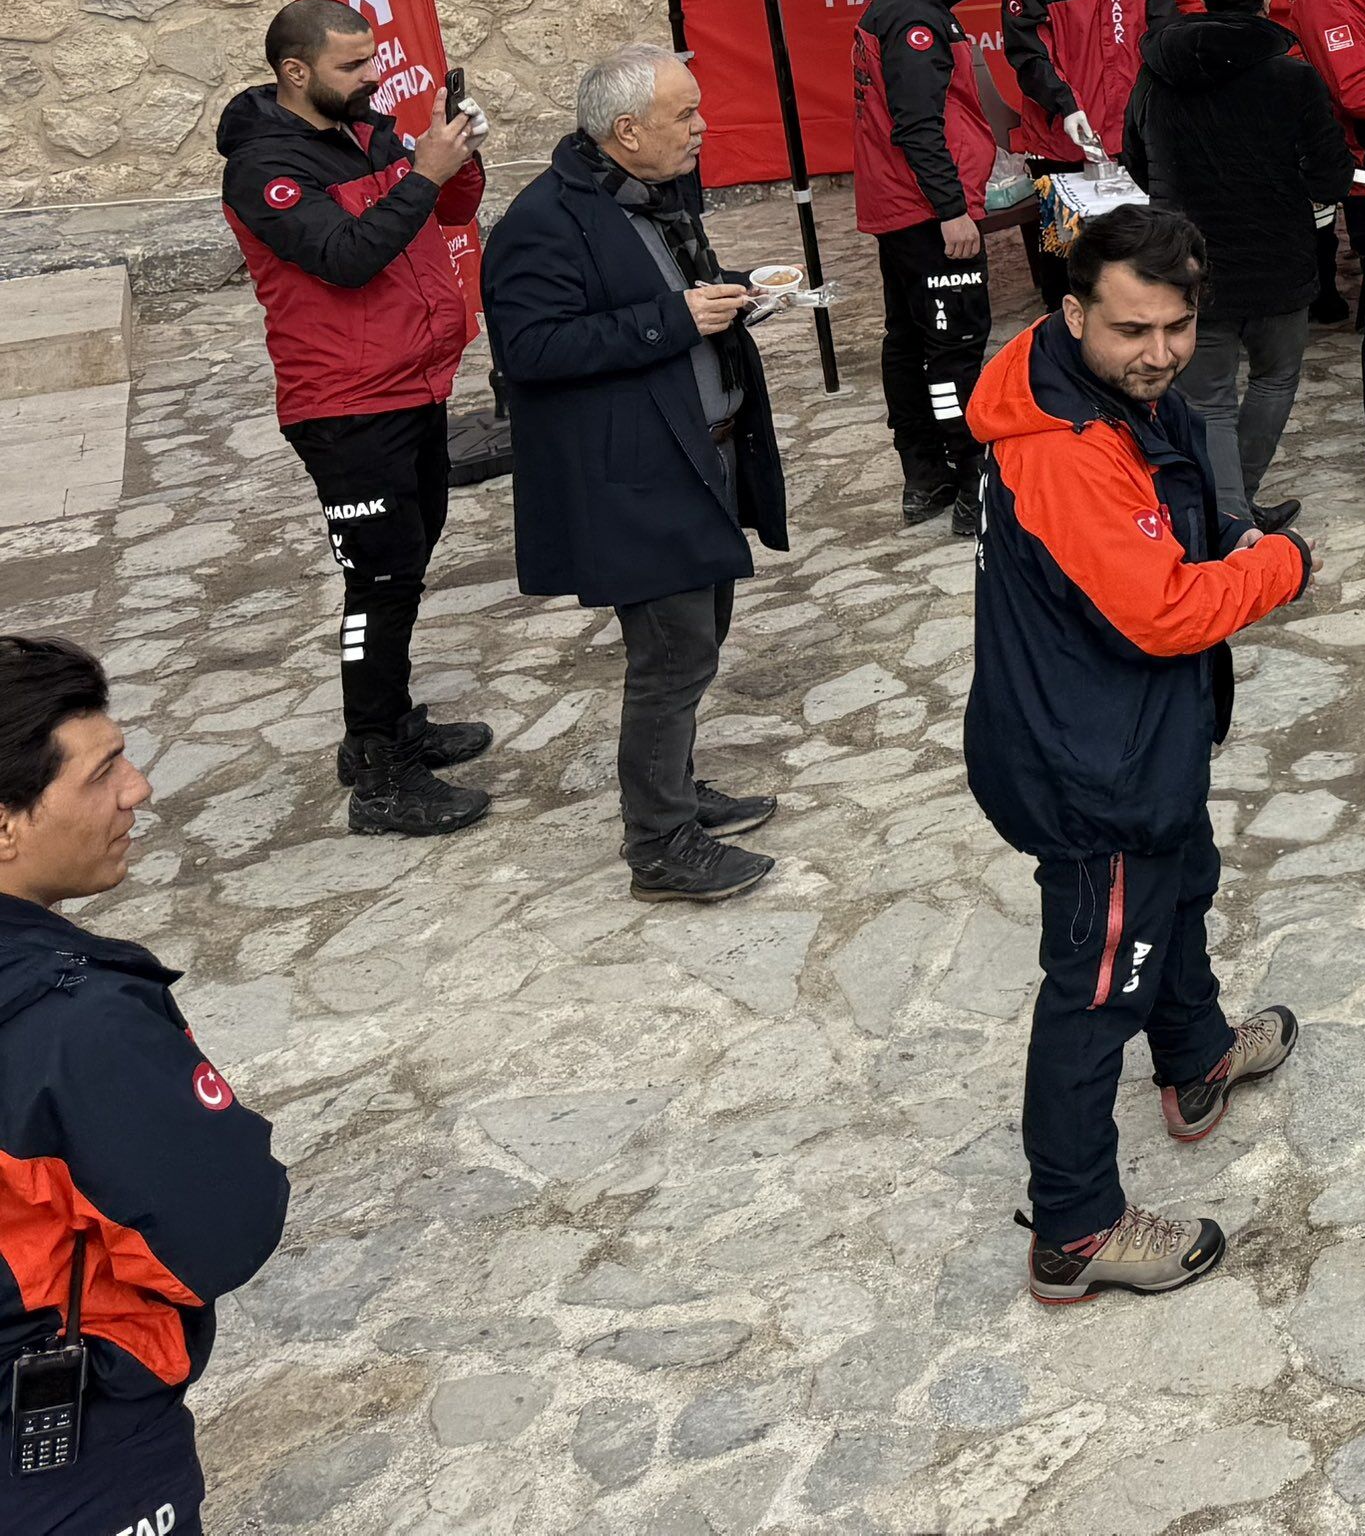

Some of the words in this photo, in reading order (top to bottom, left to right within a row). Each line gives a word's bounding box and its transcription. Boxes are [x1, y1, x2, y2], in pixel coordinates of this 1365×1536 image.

[927, 272, 982, 289] HADAK
[934, 298, 948, 331] VAN
[325, 498, 387, 520] HADAK
